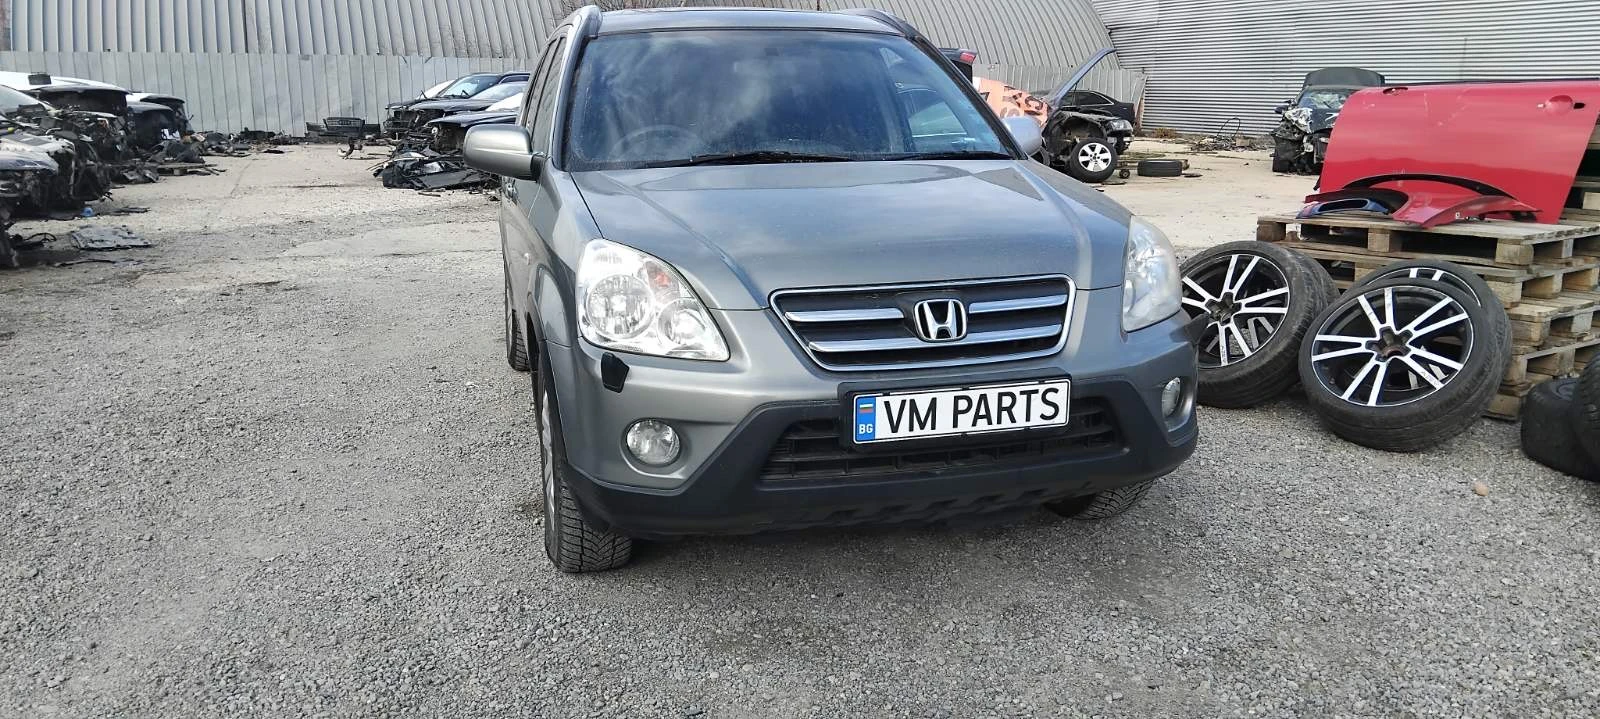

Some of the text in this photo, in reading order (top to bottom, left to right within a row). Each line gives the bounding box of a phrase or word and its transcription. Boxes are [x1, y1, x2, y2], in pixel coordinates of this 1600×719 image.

[884, 387, 1060, 433] VM PARTS
[859, 423, 874, 435] BG
